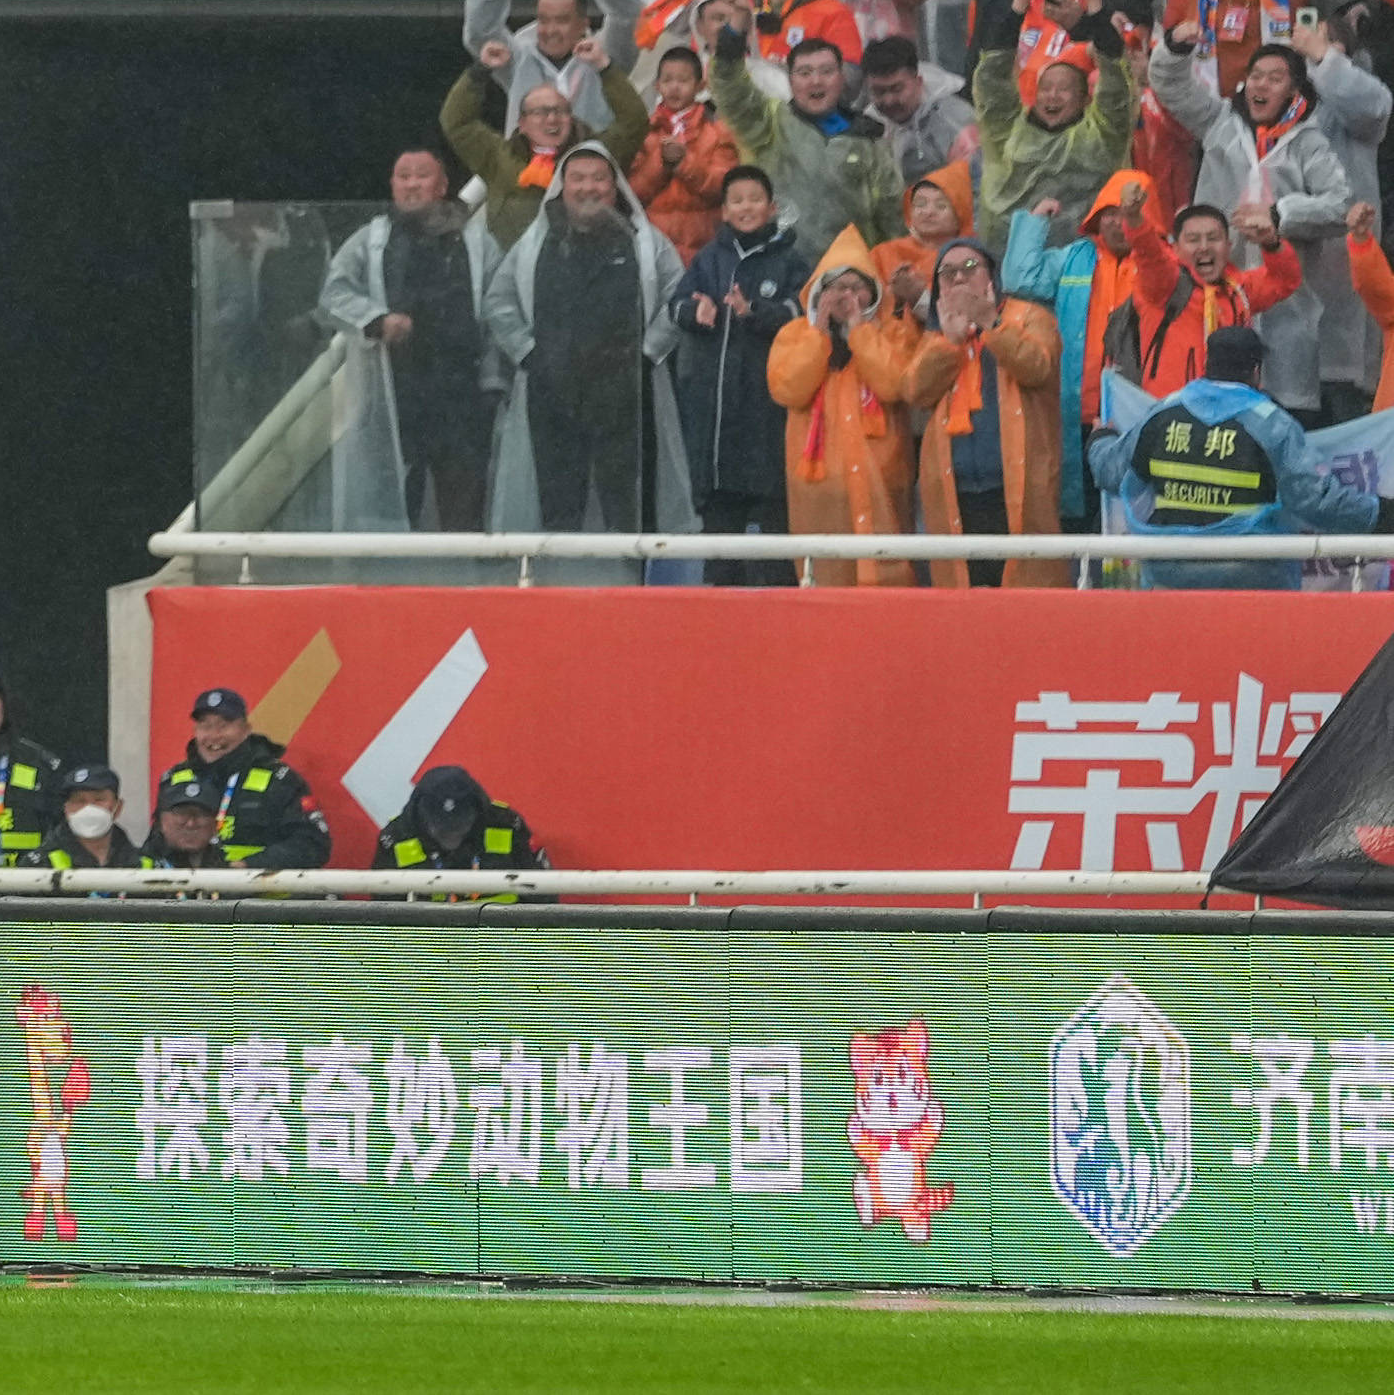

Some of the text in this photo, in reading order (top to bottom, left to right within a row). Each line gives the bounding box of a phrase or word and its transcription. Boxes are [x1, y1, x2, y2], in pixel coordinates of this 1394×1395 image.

[1165, 420, 1238, 460] 振邦
[1163, 481, 1233, 506] SECURITY
[134, 1033, 803, 1193] 探索奇妙动物王国
[1231, 1032, 1394, 1171] 济南
